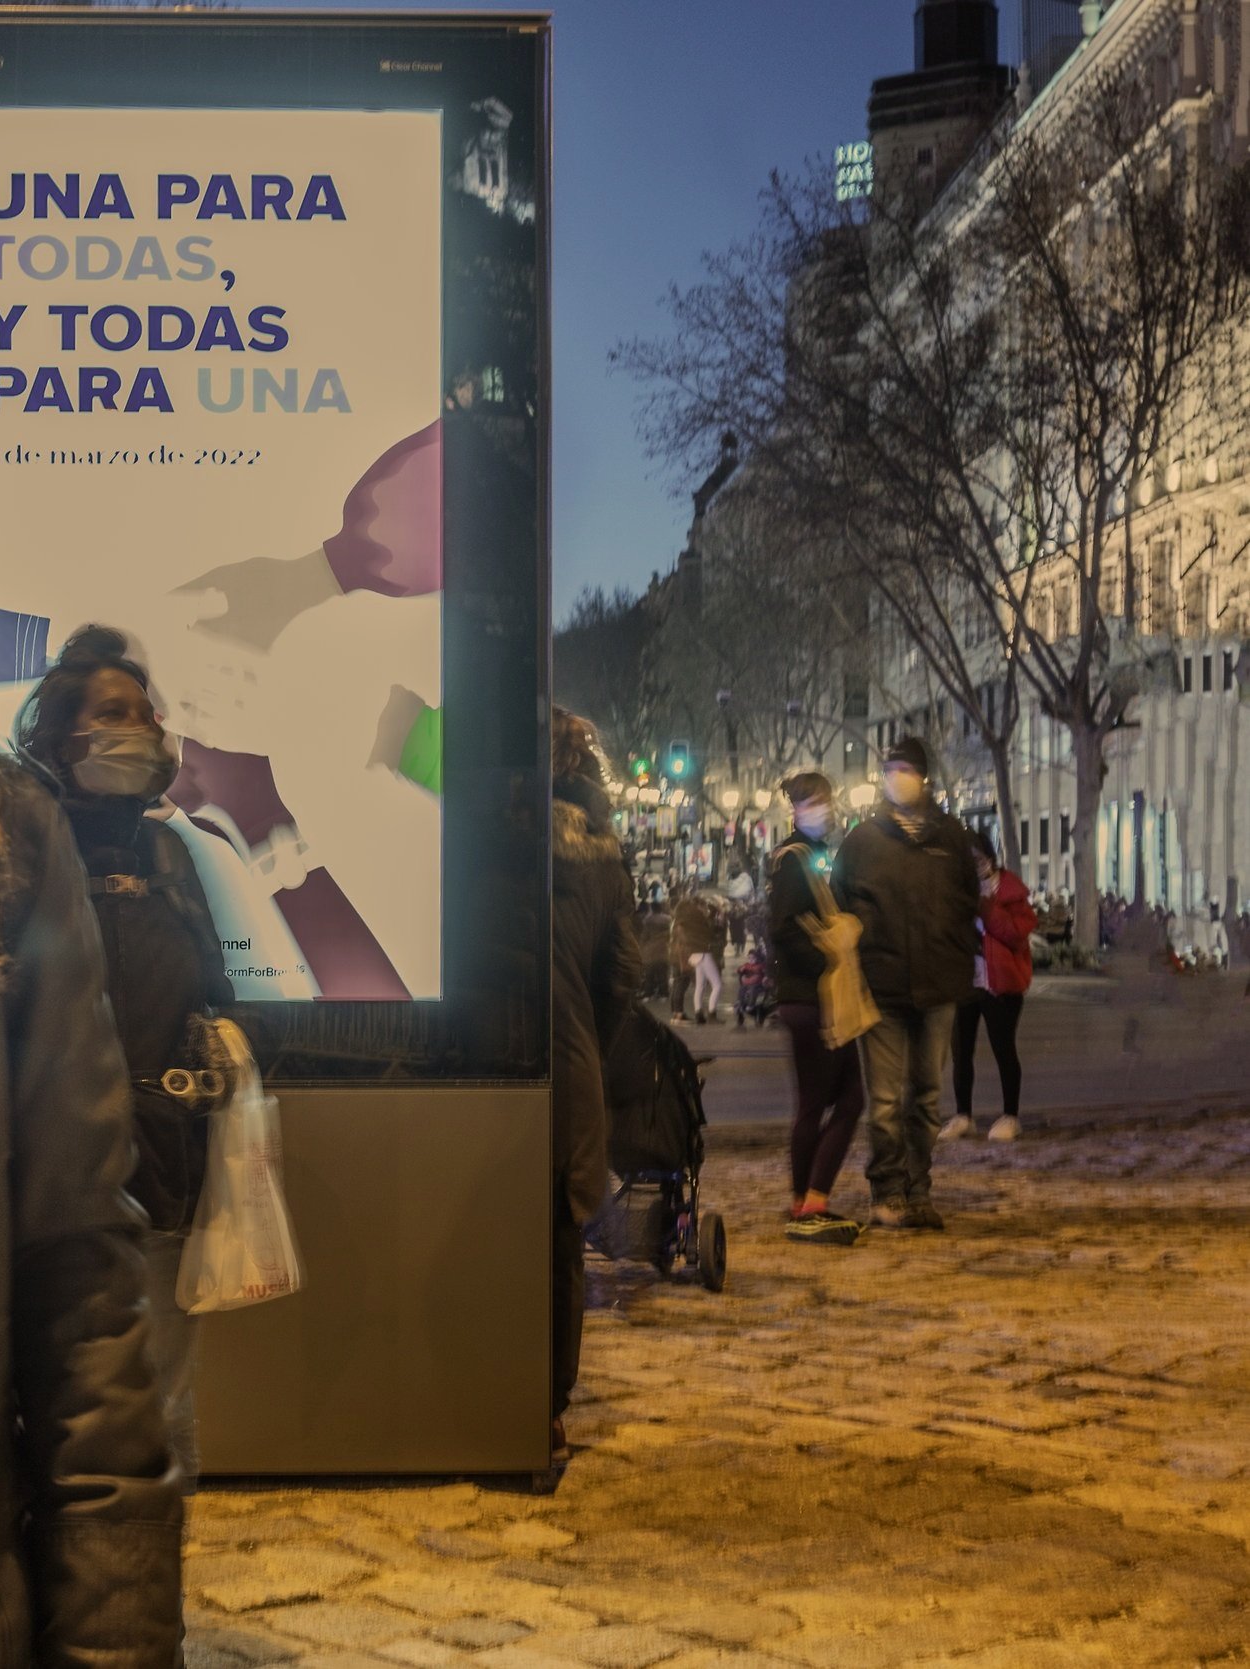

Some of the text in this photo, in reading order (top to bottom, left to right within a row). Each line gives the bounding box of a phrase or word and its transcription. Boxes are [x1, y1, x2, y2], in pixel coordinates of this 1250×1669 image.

[157, 173, 347, 221] PARA
[48, 304, 290, 352] TODAS
[196, 367, 353, 414] UNA
[4, 444, 41, 465] de
[50, 448, 140, 465] marzo
[148, 444, 185, 465] de
[193, 448, 262, 465] 2022
[219, 938, 251, 950] nnel
